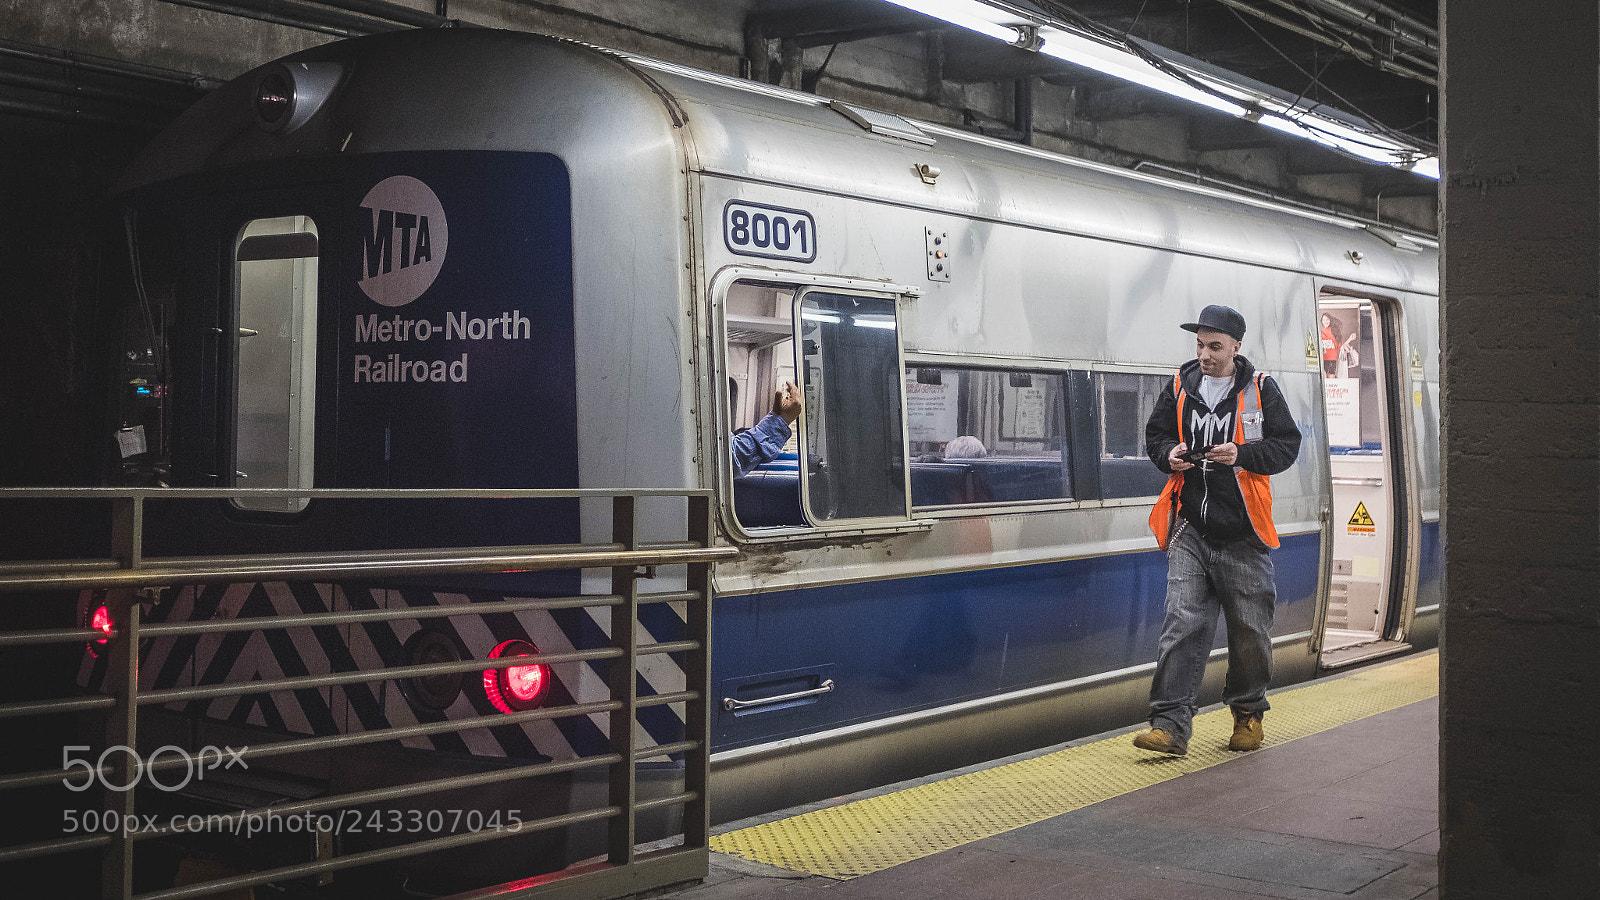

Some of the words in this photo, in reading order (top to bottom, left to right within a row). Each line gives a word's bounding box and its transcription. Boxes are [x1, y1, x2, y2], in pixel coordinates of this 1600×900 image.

[356, 204, 432, 280] MTA
[731, 209, 807, 253] 8001
[355, 310, 531, 343] Metro-North
[354, 353, 468, 383] Railroad
